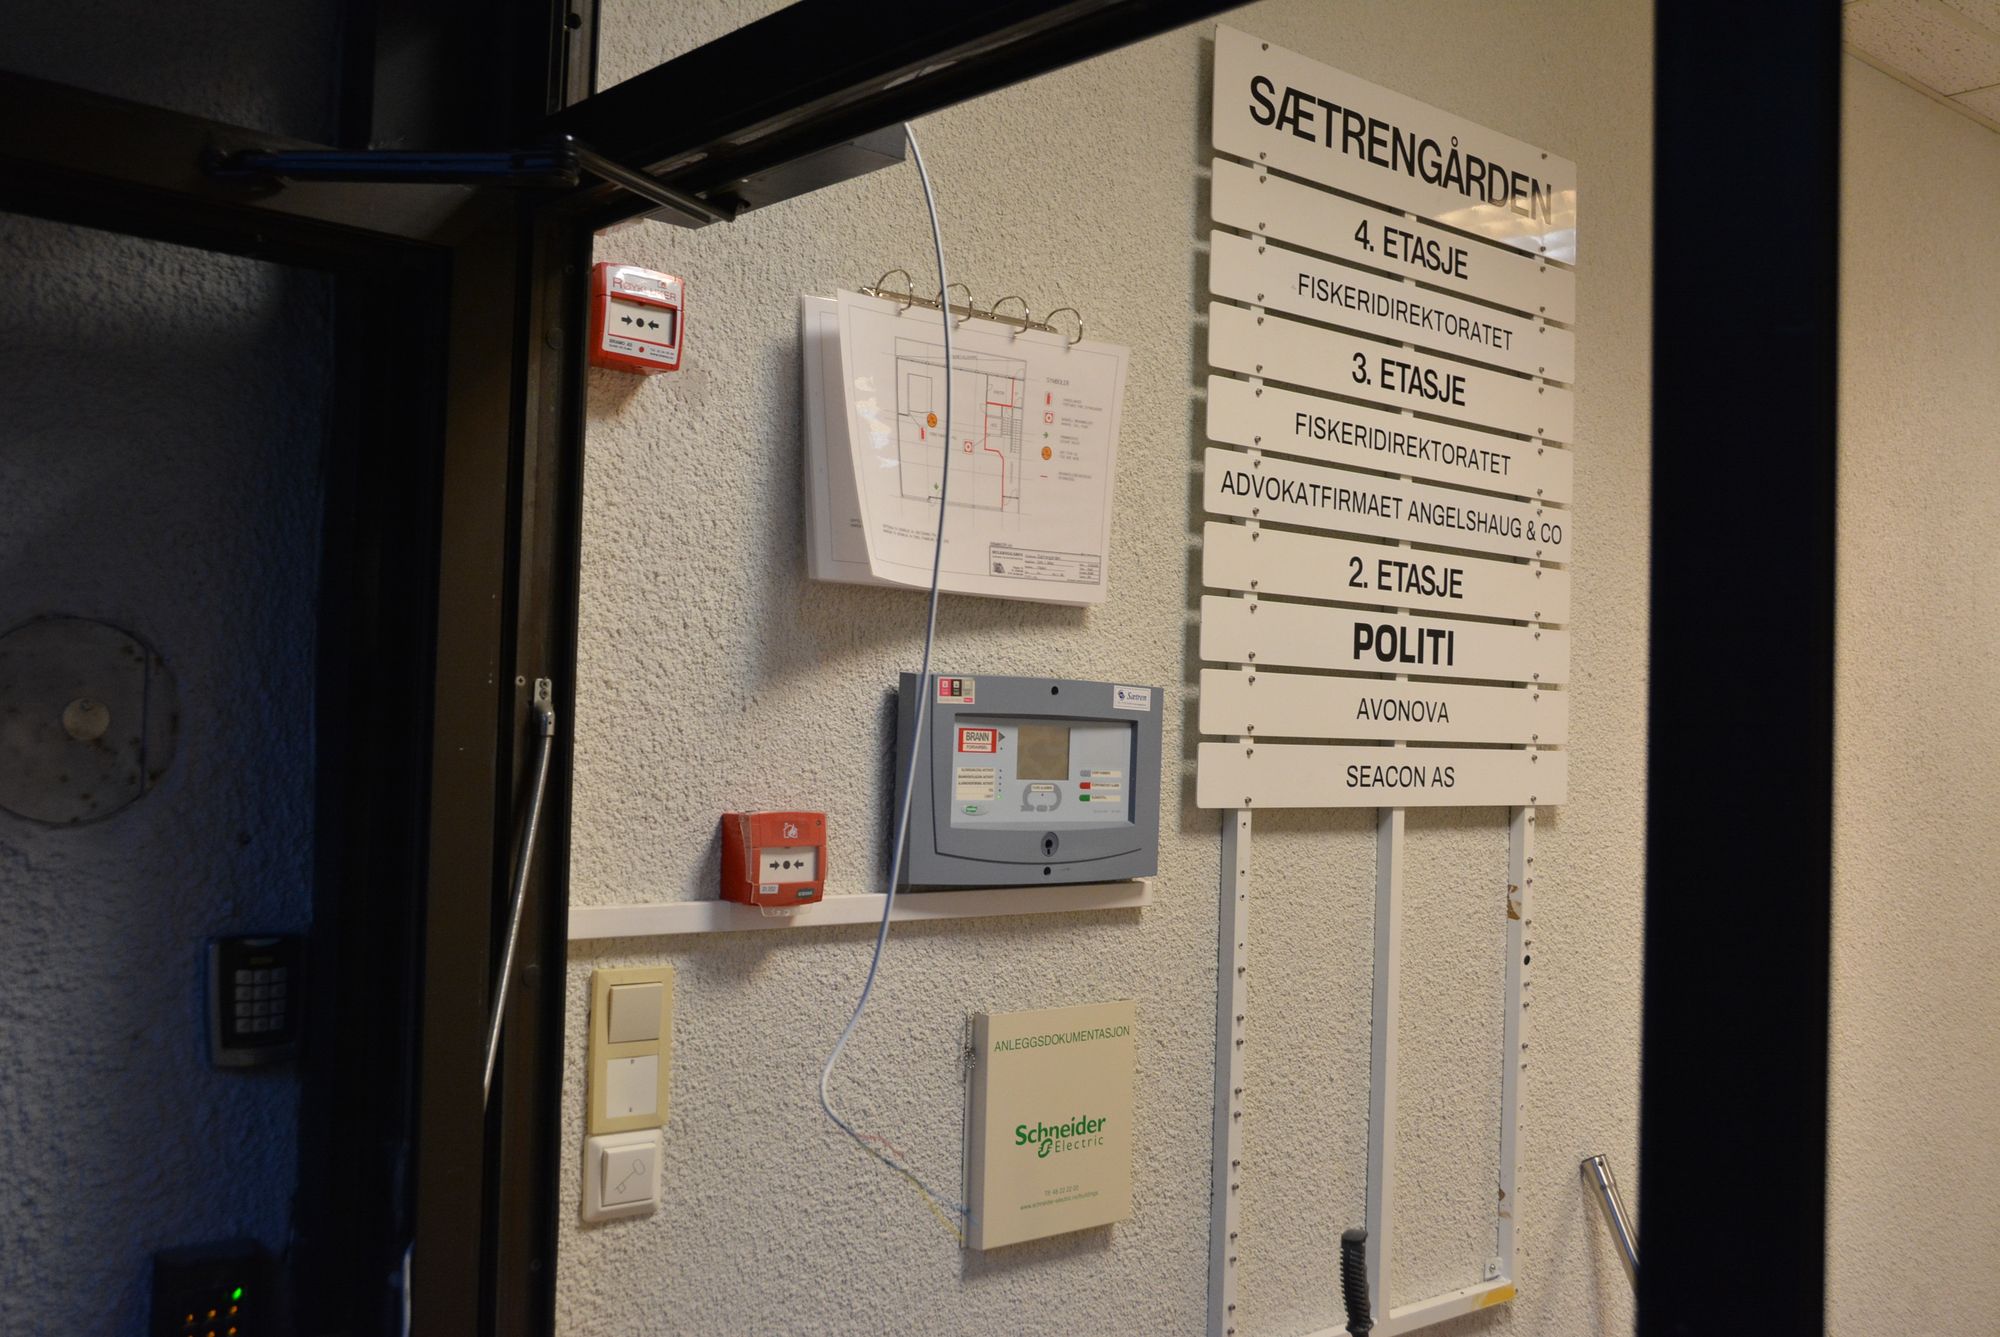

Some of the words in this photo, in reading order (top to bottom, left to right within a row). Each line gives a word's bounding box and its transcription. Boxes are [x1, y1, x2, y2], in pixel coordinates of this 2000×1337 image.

[1249, 75, 1552, 225] SÆTRENGÅRDEN
[1354, 219, 1374, 252] 4.
[1384, 226, 1468, 279] ETASJE
[1298, 273, 1513, 350] FISKERIDIREKTORATET
[1352, 352, 1371, 385] 3.
[1381, 357, 1466, 407] ETASJE
[1295, 412, 1511, 476] FISKERIDIREKTORATET
[1220, 470, 1402, 519] ADVOKATFIRMAET
[1407, 503, 1522, 539] ANGELSHAUG
[1526, 519, 1537, 541] &
[1541, 522, 1562, 545] CO
[1348, 556, 1368, 589] 2.
[1377, 559, 1463, 599] ETASJE
[1353, 622, 1454, 666] POLITI
[1357, 697, 1450, 723] AVONOVA
[965, 731, 990, 742] BRANN
[1346, 765, 1426, 788] SEACON
[1431, 765, 1455, 788] AS
[994, 1025, 1130, 1052] ANLEGGSDOKUMENTASJON
[1015, 1115, 1106, 1146] Schneider
[1055, 1135, 1104, 1153] Electric
